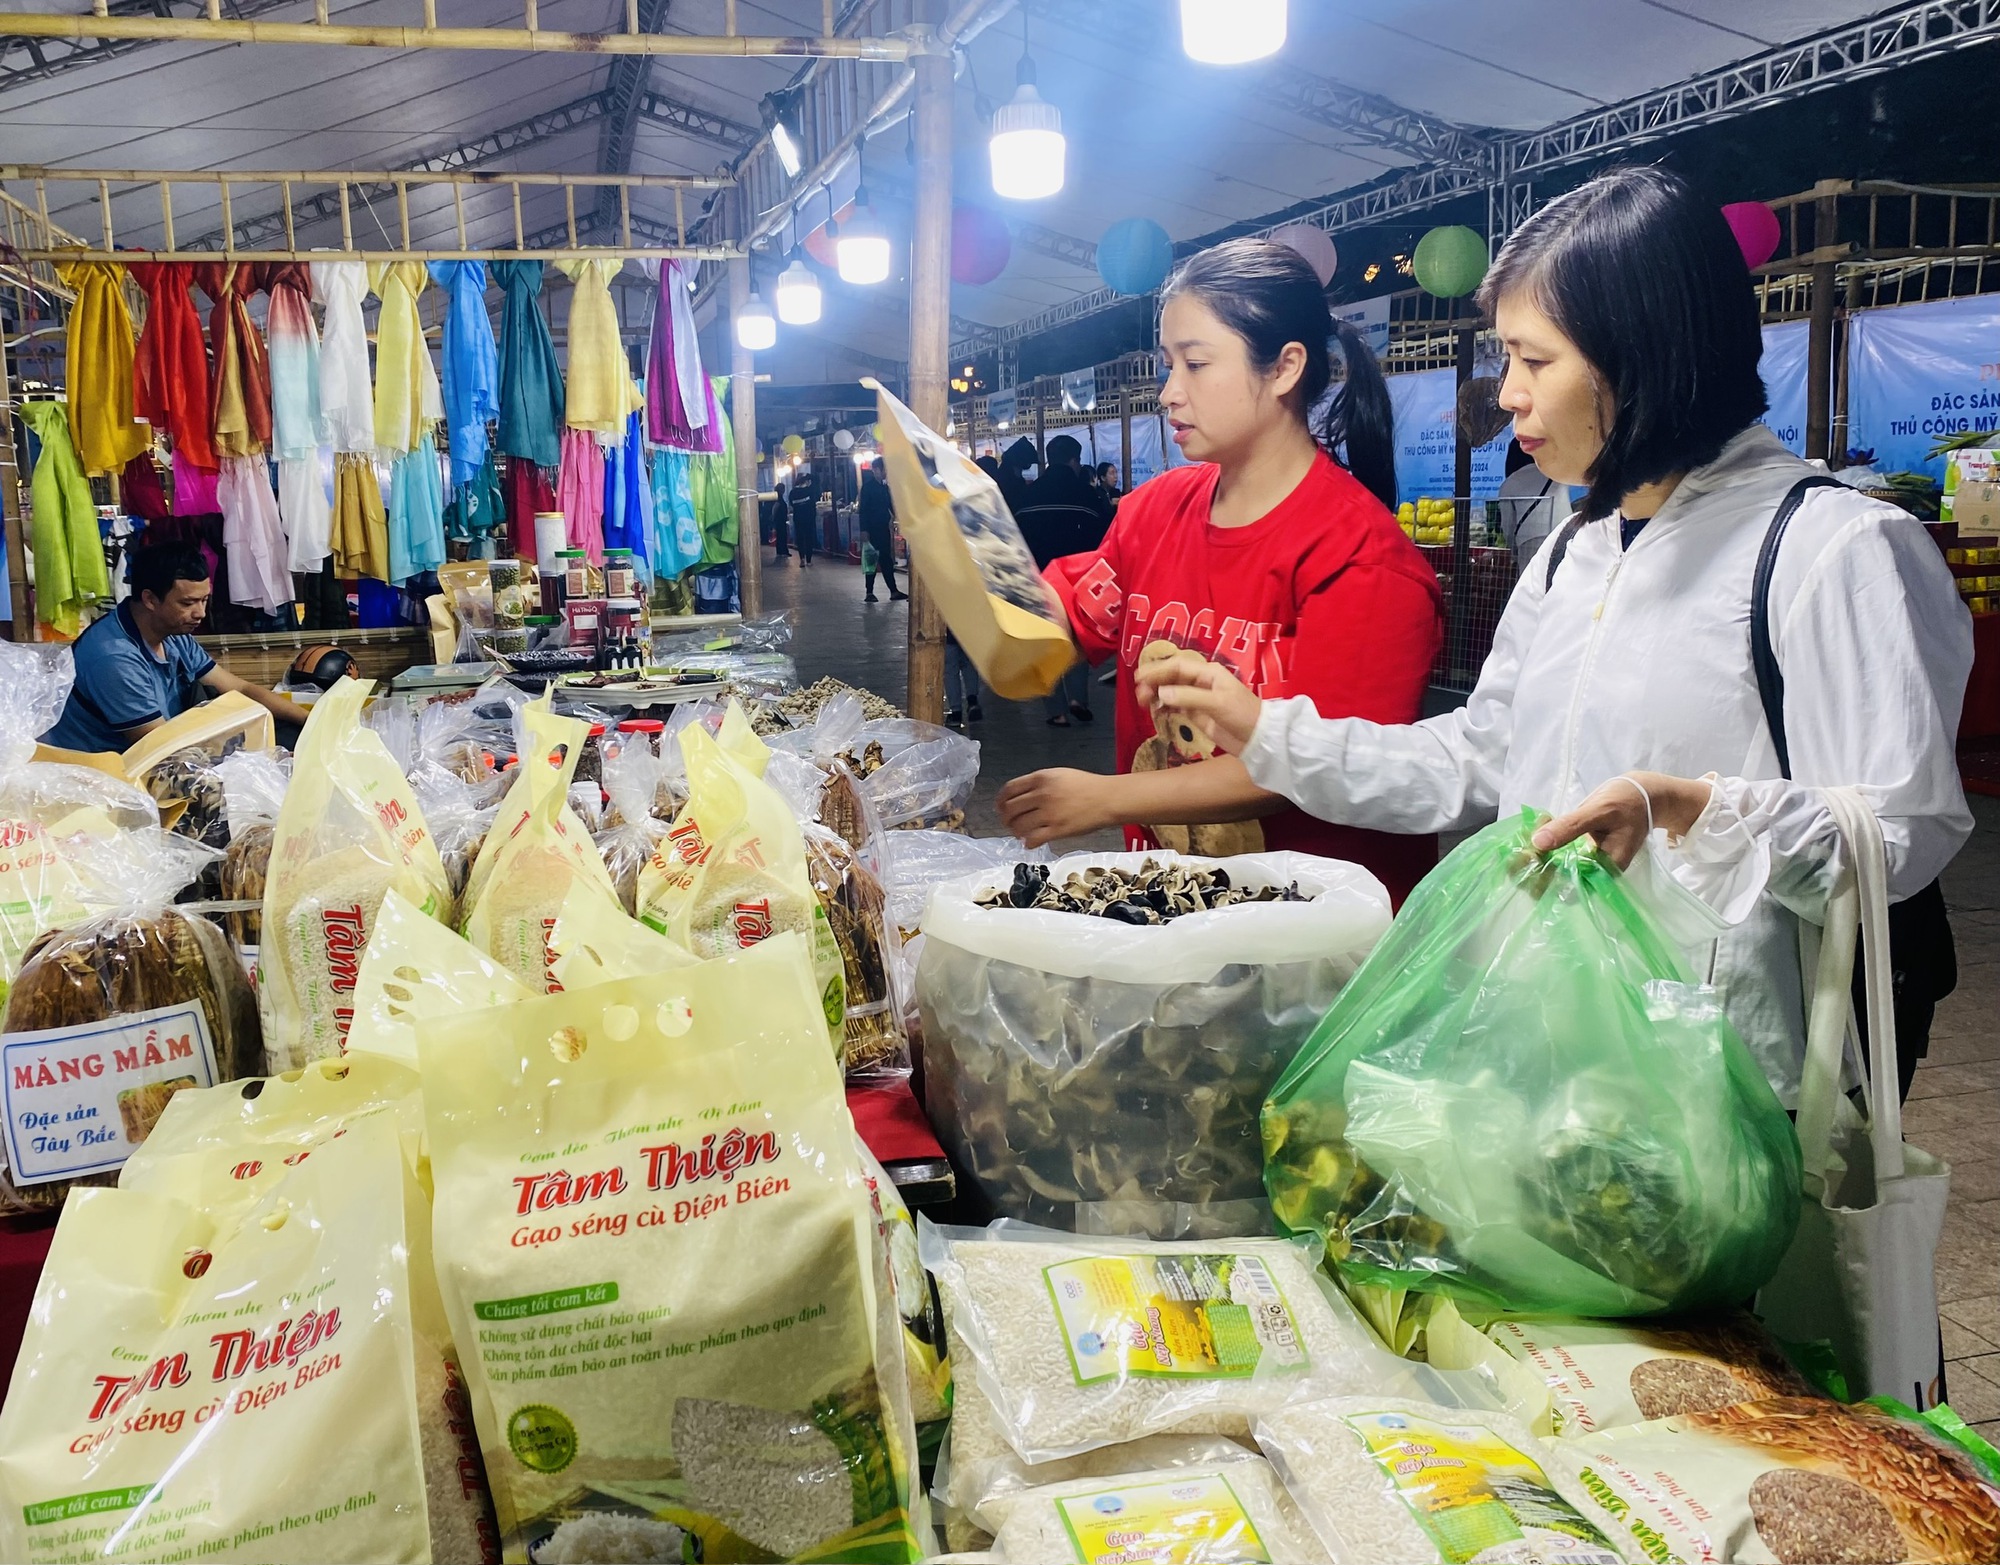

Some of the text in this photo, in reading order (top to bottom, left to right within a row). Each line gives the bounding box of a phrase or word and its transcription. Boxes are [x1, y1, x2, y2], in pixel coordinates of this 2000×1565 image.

[1931, 388, 2000, 414] ĐẶC SẢN
[1777, 425, 1799, 445] NỘI
[1891, 415, 1917, 436] THỦ
[1922, 413, 1969, 435] CÔNG
[1417, 443, 1436, 456] CÔNG
[1442, 464, 1450, 473] 25
[321, 903, 366, 994] Tâm
[14, 1030, 194, 1090] MĂNG MẦM
[19, 1104, 99, 1131] Đặc sản
[31, 1125, 118, 1153] Tây Bắc
[512, 1126, 781, 1217] Tâm Thiện
[510, 1175, 791, 1249] Gạo séng cù Điện Biên
[483, 1283, 607, 1319] Chúng tôi cam kết
[208, 1305, 341, 1383] Thiện
[479, 1327, 517, 1346] Không
[520, 1326, 537, 1342] sử
[539, 1323, 573, 1341] dụng
[576, 1315, 606, 1333] chất
[609, 1310, 634, 1327] bảo
[483, 1347, 521, 1364] Không
[549, 1344, 566, 1358] dư
[570, 1338, 600, 1355] chất
[603, 1333, 627, 1350] độc
[631, 1327, 653, 1345] hại
[511, 1364, 546, 1385] phẩm
[609, 1355, 626, 1368] an
[631, 1347, 662, 1364] toàn
[665, 1341, 696, 1358] thực
[699, 1327, 738, 1354] phẩm
[740, 1321, 770, 1341] theo
[772, 1313, 796, 1333] quy
[798, 1301, 828, 1324] định
[120, 1406, 186, 1435] séng
[234, 1381, 288, 1416] Điện
[293, 1352, 343, 1391] Biên
[28, 1502, 65, 1524] Chúng
[67, 1498, 87, 1514] tôi
[90, 1495, 123, 1509] cam
[197, 1536, 230, 1556] thực
[234, 1521, 275, 1549] phẩm
[279, 1513, 312, 1532] theo
[314, 1504, 341, 1524] quy
[344, 1491, 377, 1513] định
[71, 1525, 107, 1545] dụng
[163, 1523, 187, 1543] hại
